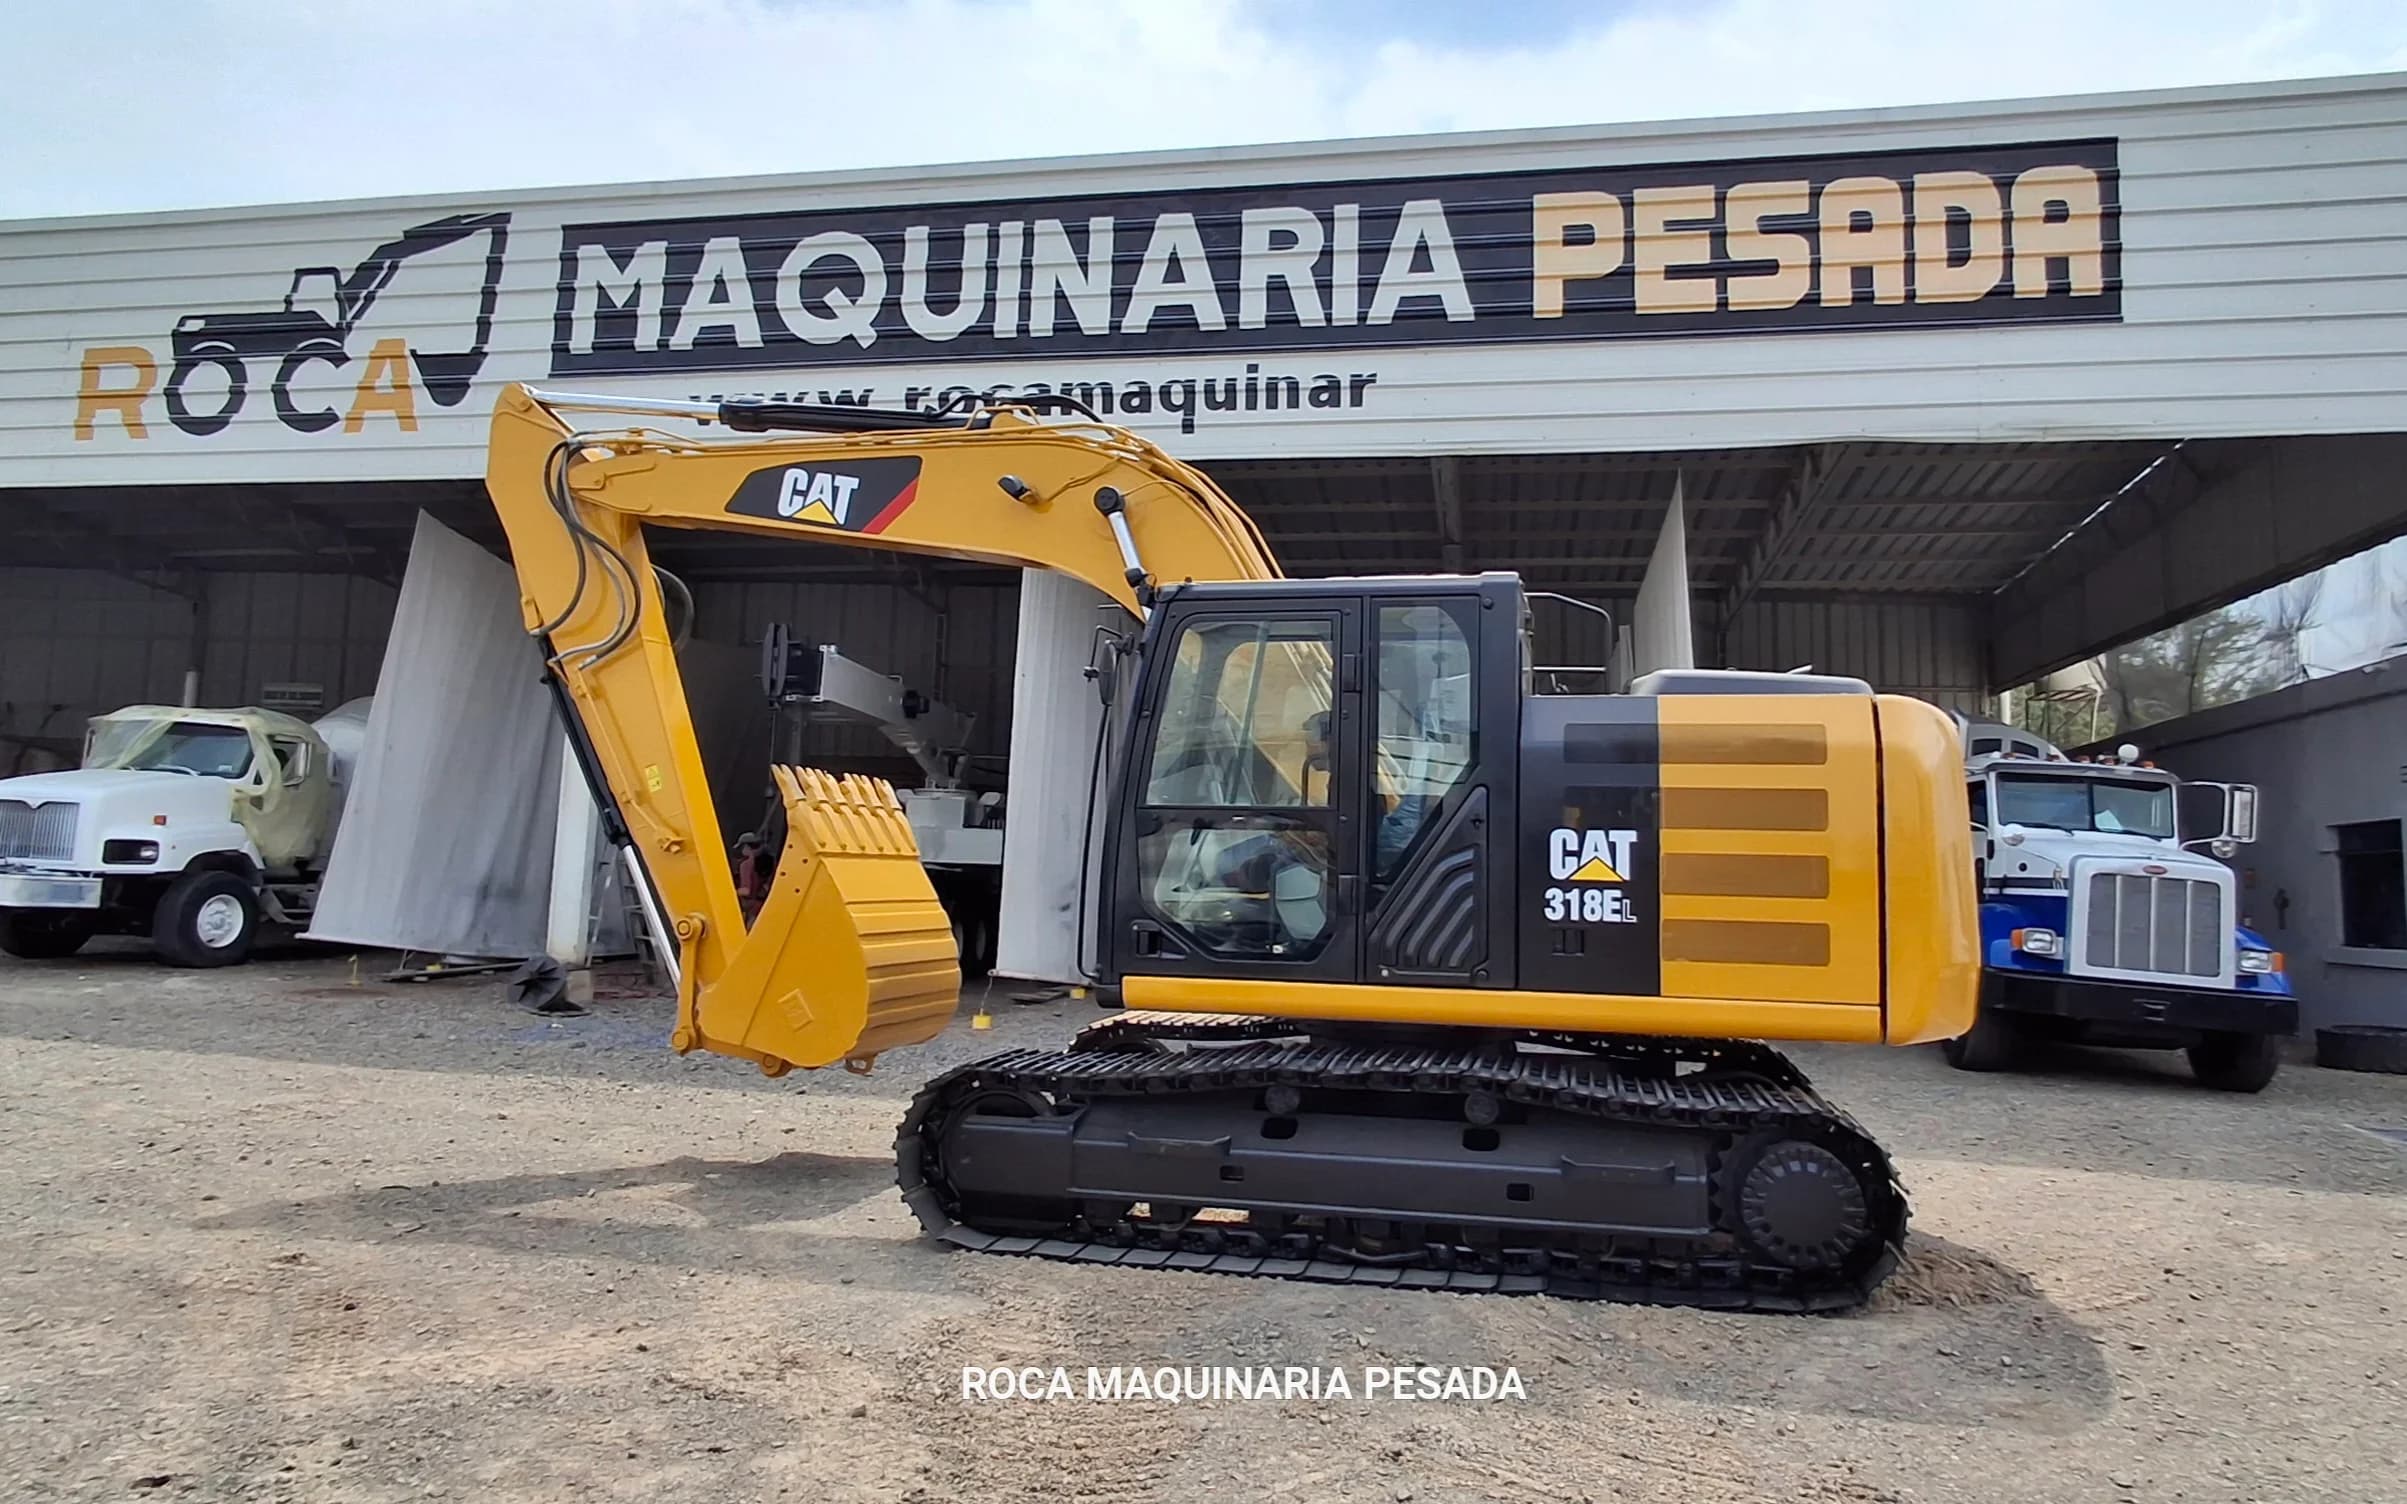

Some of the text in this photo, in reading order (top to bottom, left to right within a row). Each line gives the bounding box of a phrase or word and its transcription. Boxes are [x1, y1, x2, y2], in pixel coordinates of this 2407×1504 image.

[569, 164, 2104, 355] MAQUINARIA PESADA
[74, 338, 419, 440] ROCA
[777, 467, 860, 526] CAT
[1550, 828, 1639, 881] CAT
